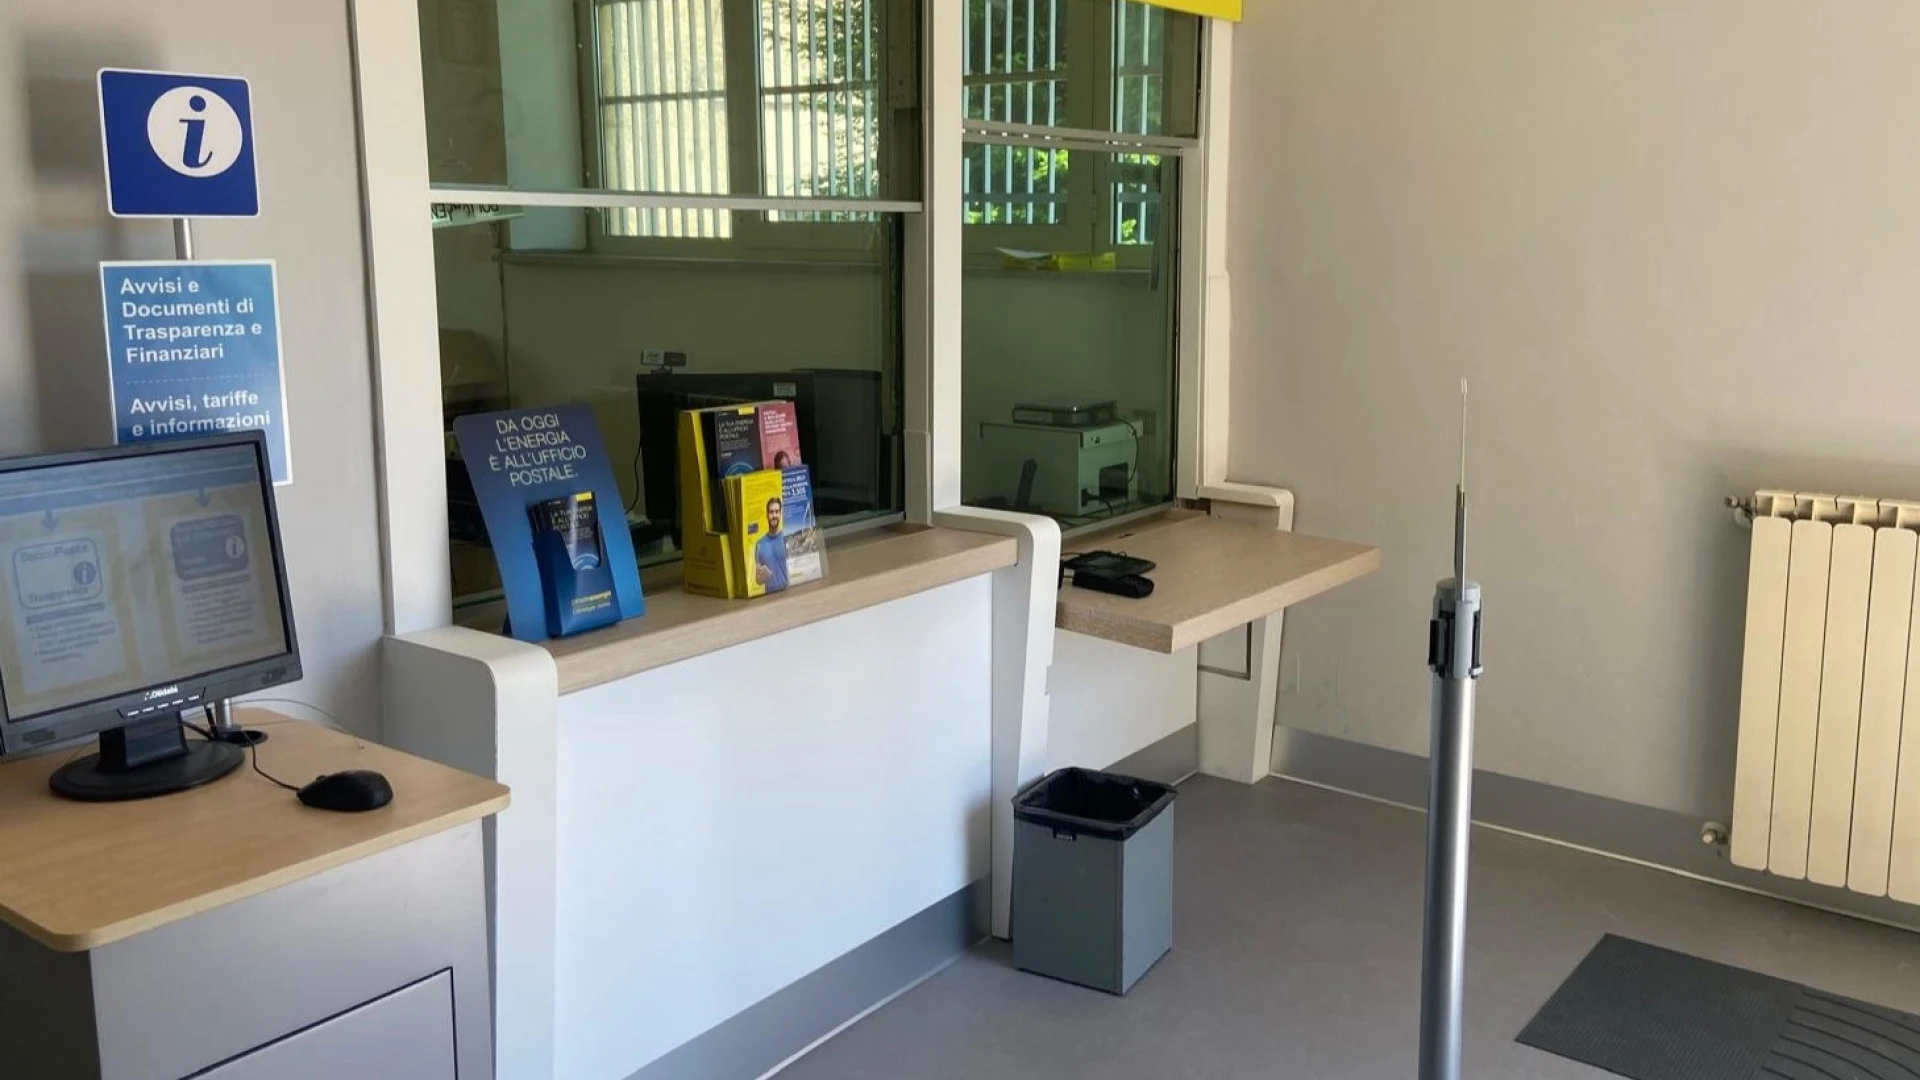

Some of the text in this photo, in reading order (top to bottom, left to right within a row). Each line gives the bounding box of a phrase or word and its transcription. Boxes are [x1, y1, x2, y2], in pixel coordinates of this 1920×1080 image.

[120, 277, 200, 295] Avvisi e
[122, 298, 254, 318] Documenti di
[123, 323, 262, 342] Trasparenza e
[126, 343, 224, 363] Finanziari
[130, 390, 259, 414] Avvisi, tariffe
[132, 411, 270, 437] e informazioni
[496, 414, 559, 434] DA OGGI
[496, 431, 571, 452] L'ENERGIA
[489, 445, 587, 471] È ALL'UFFICIO
[509, 465, 579, 487] POSTALE.
